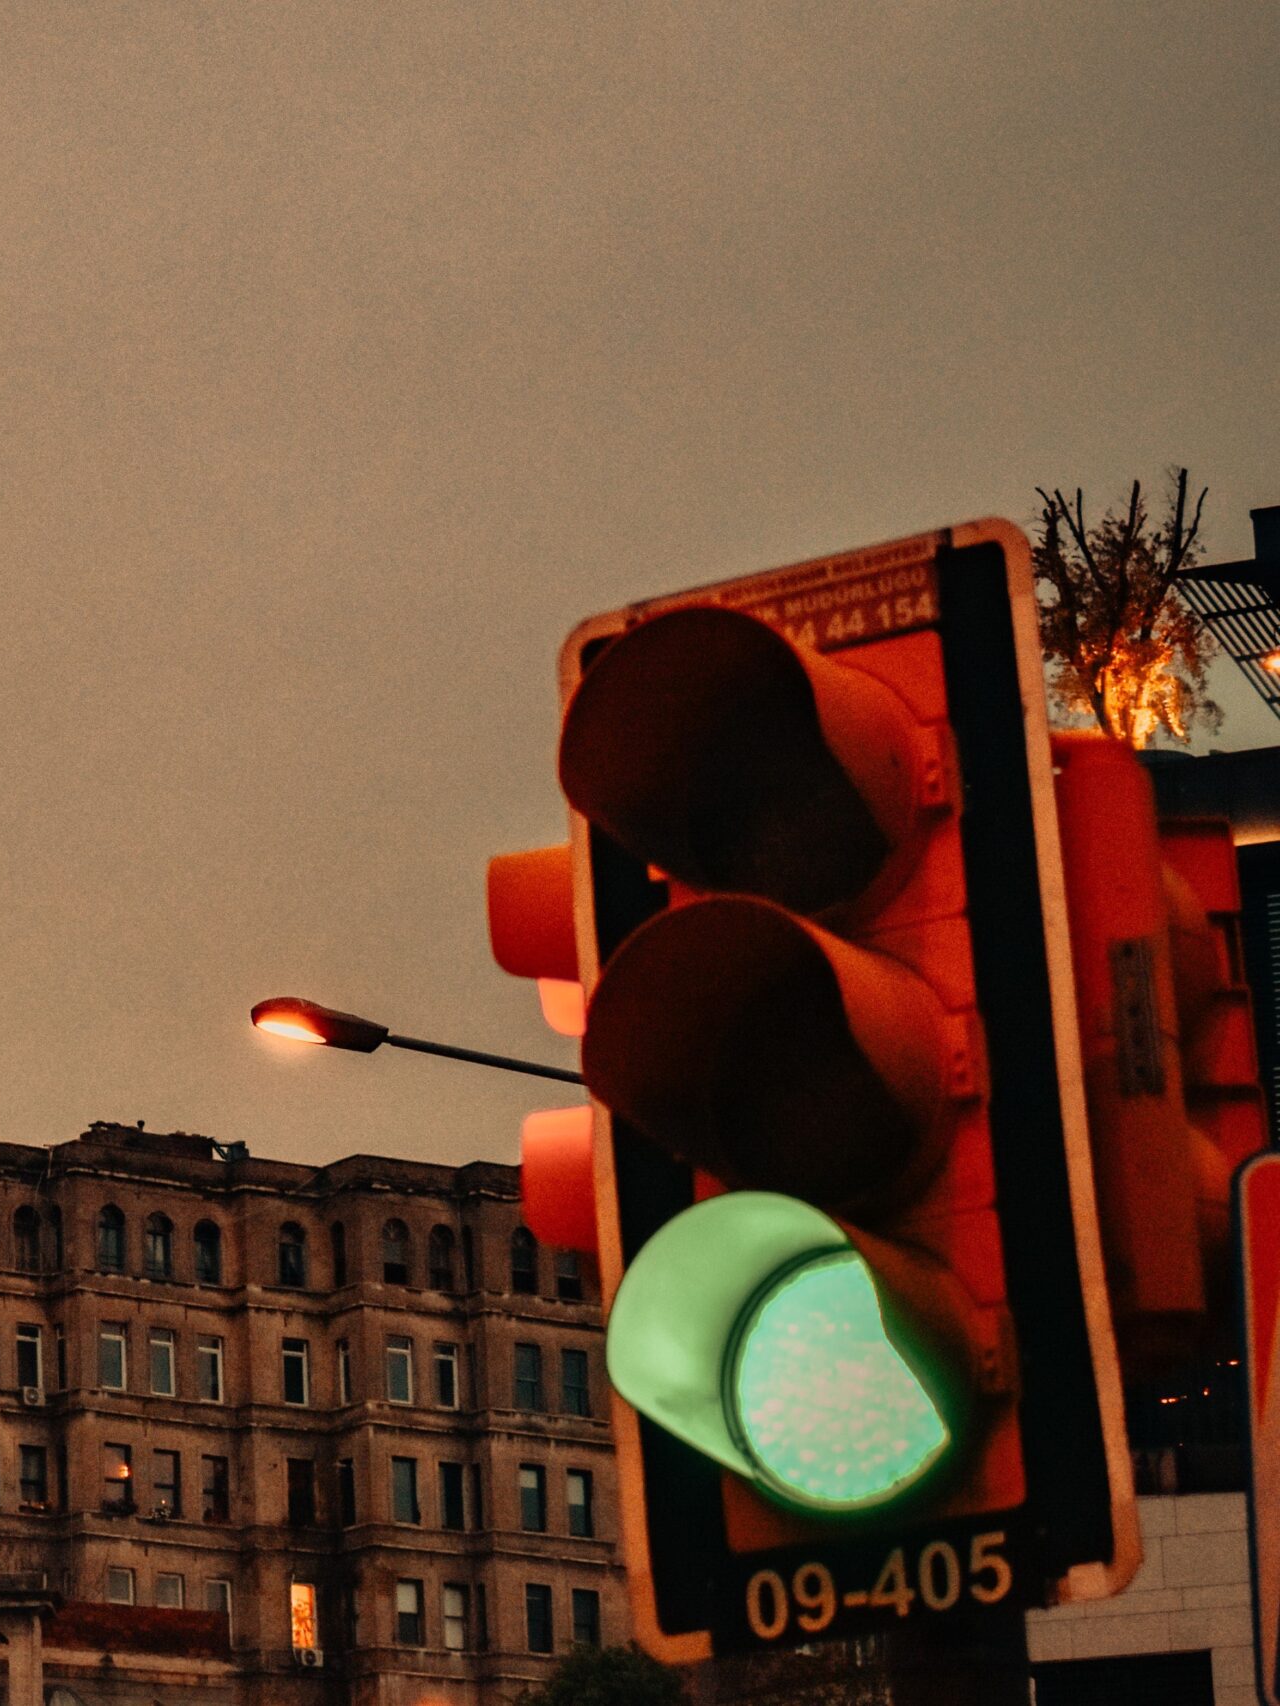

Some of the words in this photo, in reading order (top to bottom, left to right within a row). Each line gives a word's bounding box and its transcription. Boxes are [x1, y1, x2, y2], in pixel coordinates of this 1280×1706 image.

[825, 608, 866, 640] 44
[876, 592, 934, 629] 154
[746, 1530, 1013, 1640] 09-405
